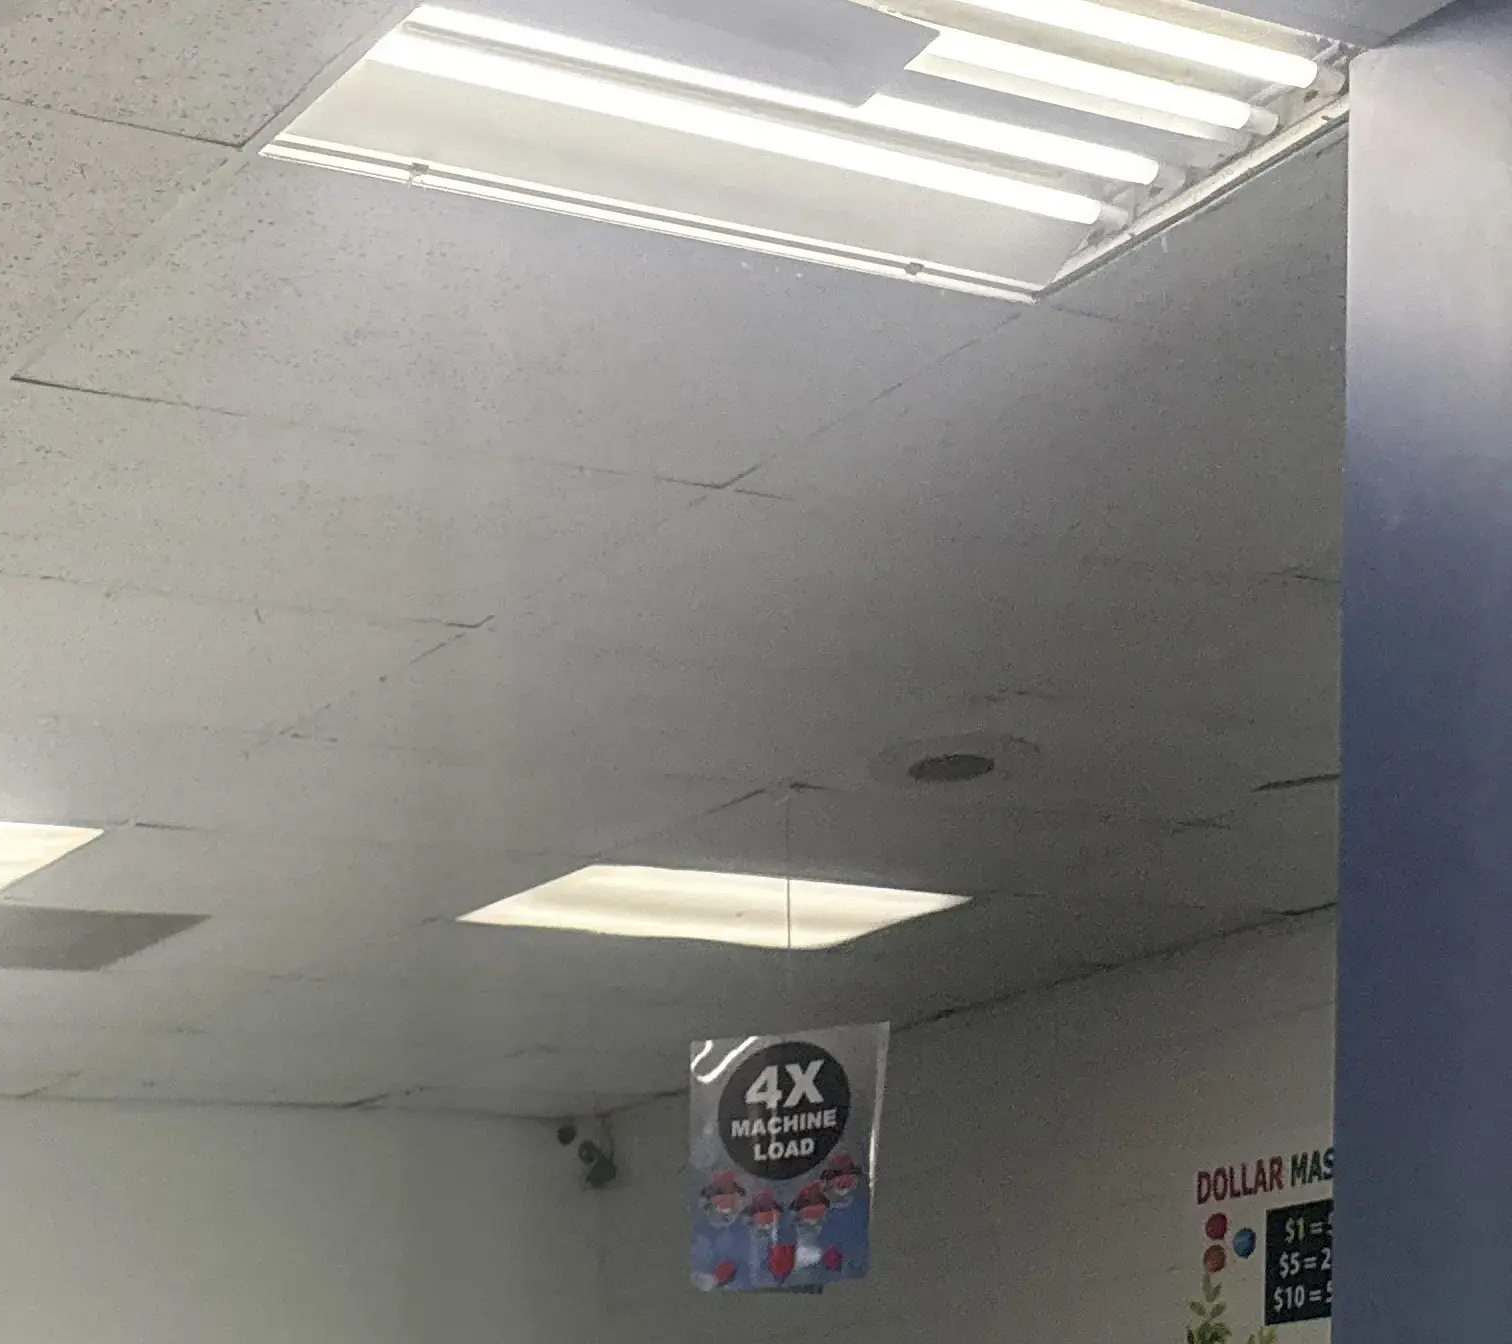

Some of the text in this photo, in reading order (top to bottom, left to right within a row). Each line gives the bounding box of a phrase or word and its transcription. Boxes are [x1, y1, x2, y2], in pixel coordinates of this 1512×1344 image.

[745, 1059, 825, 1110] 4X
[731, 1109, 837, 1140] MACHINE
[754, 1137, 815, 1161] LOAD
[1196, 1156, 1284, 1205] DOLLAR
